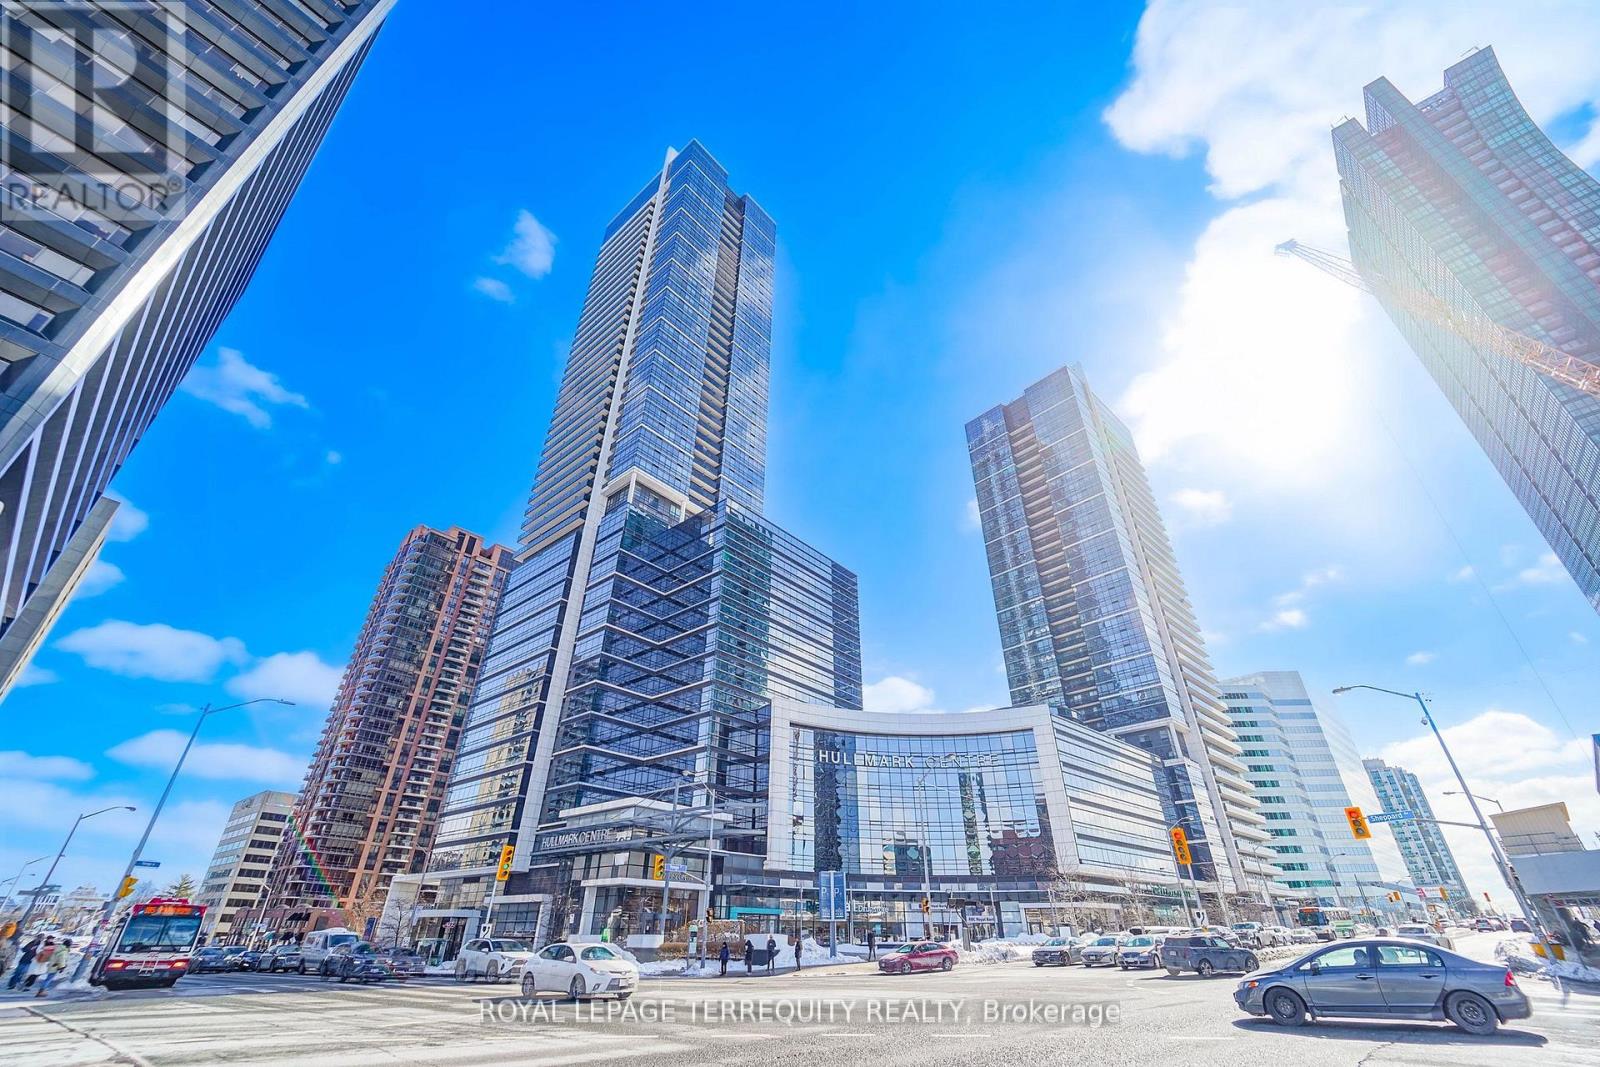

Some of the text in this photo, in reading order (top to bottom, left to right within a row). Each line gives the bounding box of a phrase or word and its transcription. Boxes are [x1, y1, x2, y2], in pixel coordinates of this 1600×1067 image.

[818, 750, 1000, 769] HULLMARK CENTRE
[1370, 812, 1403, 822] Sheppard
[541, 828, 614, 848] HULLMARK CENTRE
